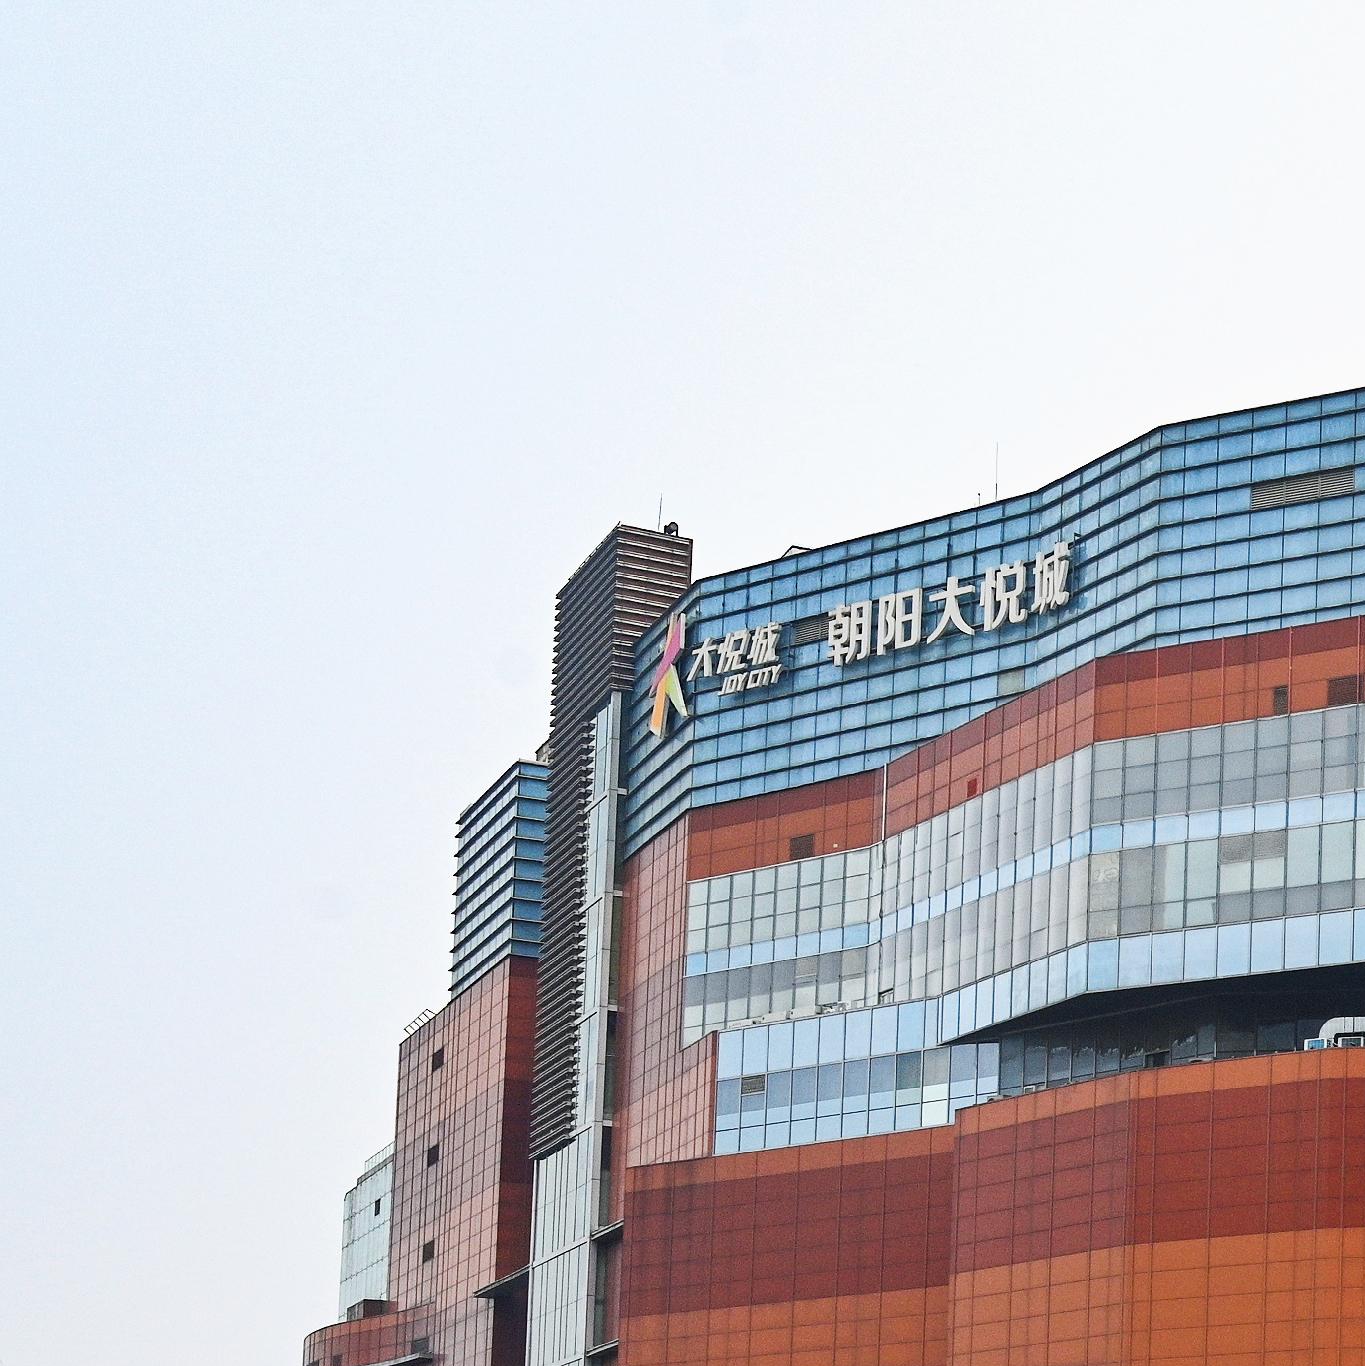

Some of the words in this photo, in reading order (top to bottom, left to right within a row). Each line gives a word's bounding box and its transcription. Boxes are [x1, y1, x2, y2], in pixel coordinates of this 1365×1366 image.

[827, 541, 1072, 667] 朝阳大悦城
[687, 621, 782, 682] 大悦城
[718, 672, 747, 696] JOY
[748, 664, 783, 690] CITY
